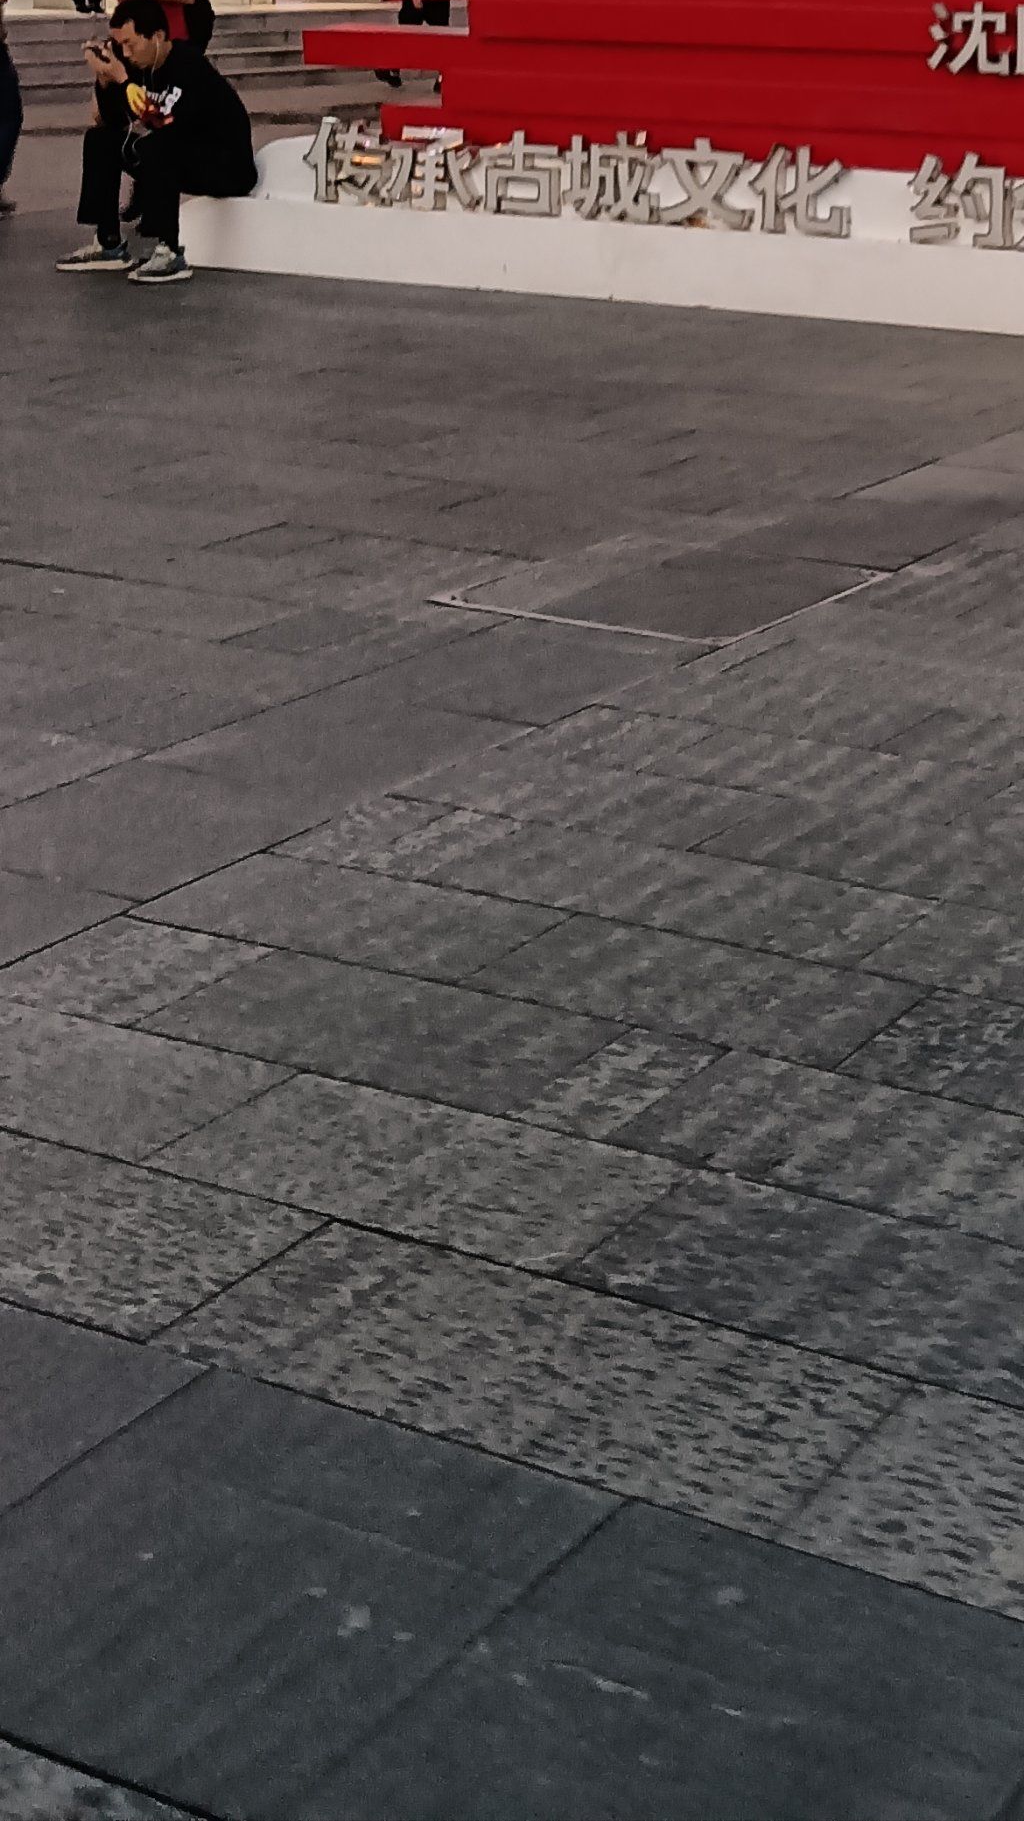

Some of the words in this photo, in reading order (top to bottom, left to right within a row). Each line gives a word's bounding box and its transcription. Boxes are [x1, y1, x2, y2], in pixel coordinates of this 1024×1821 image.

[303, 116, 851, 237] 传承古城文化
